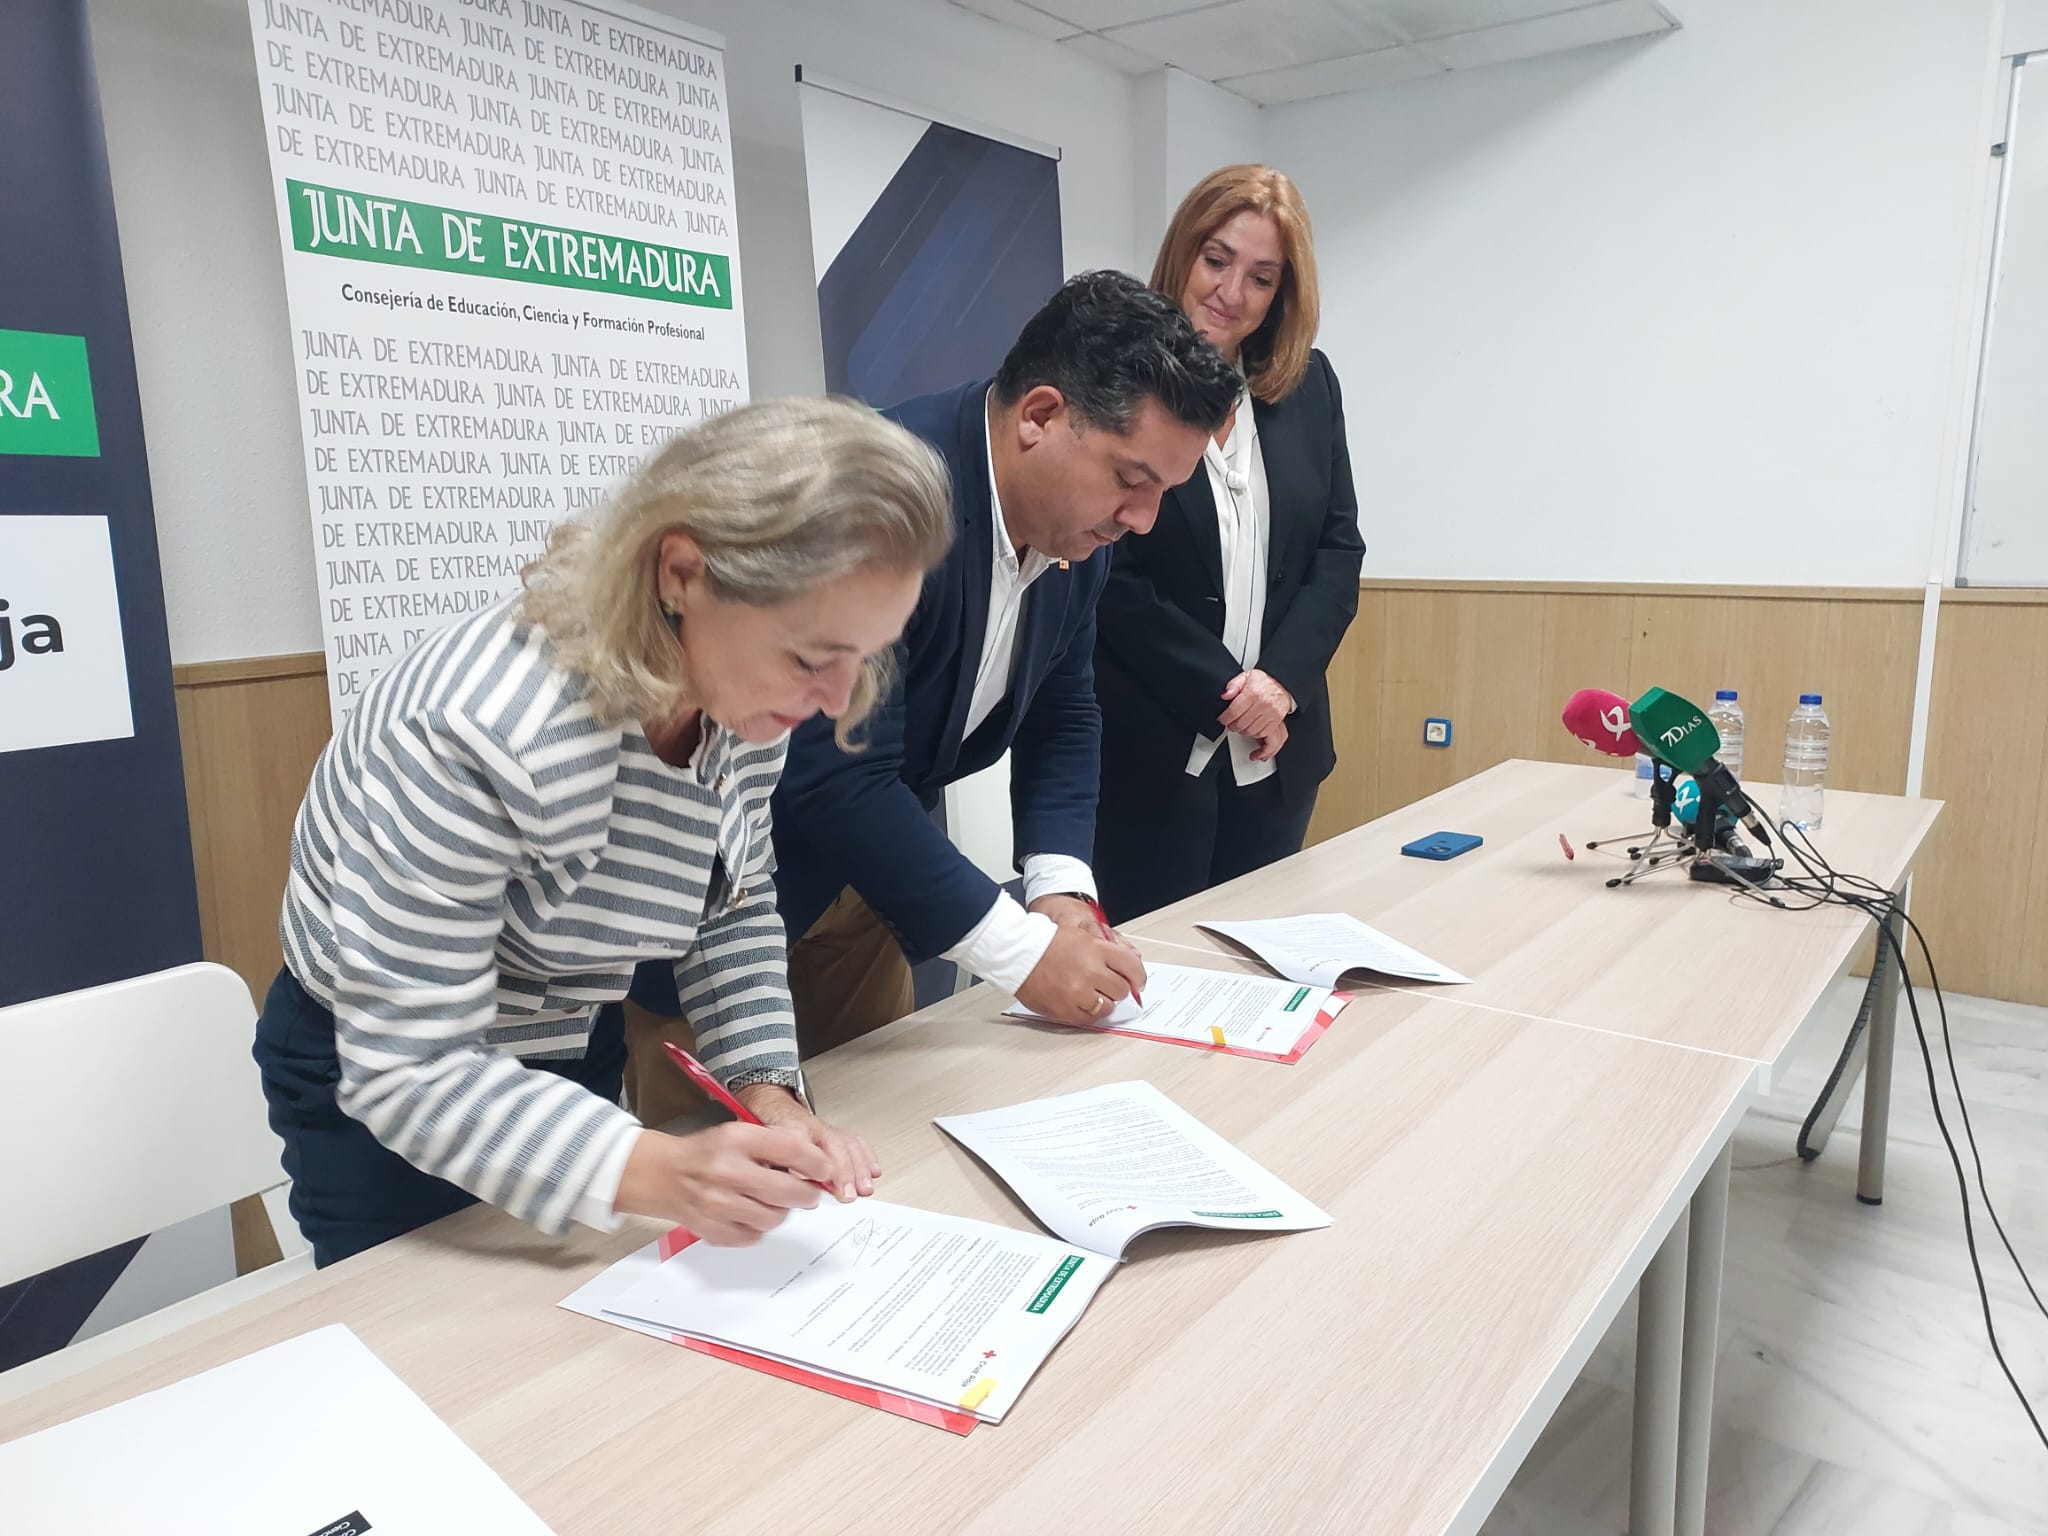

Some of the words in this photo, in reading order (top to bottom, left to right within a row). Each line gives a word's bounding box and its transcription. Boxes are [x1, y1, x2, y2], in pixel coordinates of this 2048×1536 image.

[459, 17, 516, 56] JUNTA
[524, 36, 546, 64] DE
[554, 45, 669, 100] EXTREMADURA
[676, 81, 720, 112] JUNTA
[520, 0, 573, 38] JUNTA
[580, 18, 602, 47] DE
[608, 27, 717, 81] EXTREMADURA
[264, 0, 329, 42] JUNTA
[339, 20, 366, 53] DE
[376, 31, 519, 93] EXTREMADURA
[528, 73, 579, 108] JUNTA
[587, 89, 607, 115] DE
[614, 96, 722, 144] EXTREMADURA
[266, 40, 295, 72] DE
[305, 50, 458, 114] EXTREMADURA
[467, 93, 523, 130] JUNTA
[530, 109, 552, 136] DE
[560, 116, 674, 165] EXTREMADURA
[680, 146, 724, 176] JUNTA
[272, 82, 338, 125] JUNTA
[348, 102, 375, 133] DE
[385, 111, 526, 165] EXTREMADURA
[533, 145, 584, 176] JUNTA
[593, 158, 611, 182] DE
[619, 163, 727, 207] EXTREMADURA
[277, 125, 304, 157] DE
[314, 134, 465, 189] EXTREMADURA
[474, 168, 528, 200] JUNTA
[536, 180, 557, 206] DE
[566, 185, 678, 229] EXTREMADURA
[684, 210, 728, 237] JUNTA
[303, 188, 423, 254] JUNTA
[442, 212, 485, 263] DE
[502, 223, 721, 297] EXTREMADURA
[341, 283, 423, 310] Consejería
[427, 293, 444, 311] de
[448, 296, 521, 322] Educación,
[523, 304, 569, 325] Ciencia
[572, 314, 579, 331] y
[583, 312, 645, 334] Formación
[648, 320, 705, 341] Profesional
[301, 330, 363, 360] JUNTA
[373, 337, 399, 363] DE
[408, 340, 544, 374] EXTREMADURA
[552, 354, 601, 378] JUNTA
[610, 358, 628, 380] DE
[636, 361, 740, 390] EXTREMADURA
[306, 368, 330, 396] DE
[339, 372, 486, 407] EXTREMADURA
[494, 383, 546, 409] JUNTA
[554, 386, 575, 410] DE
[583, 389, 691, 416] EXTREMADURA
[698, 397, 737, 421] JUNT
[310, 408, 370, 438] JUNTA
[381, 413, 405, 437] DE
[416, 414, 549, 442] EXTREMADURA
[558, 421, 606, 446] JUNTA
[616, 424, 634, 445] DE
[314, 447, 338, 472] DE
[348, 449, 491, 474] EXTREMADURA
[501, 453, 551, 478] JUNTA
[561, 455, 580, 475] DE
[317, 485, 378, 515] JUNTA
[388, 485, 413, 511] DE
[423, 486, 555, 509] EXTREMADURA
[323, 524, 345, 548] DE
[355, 521, 497, 546] EXTREMADURA
[327, 560, 384, 590] JUNTA
[394, 557, 422, 582] DE
[431, 553, 545, 580] EXTREMAD
[329, 597, 354, 624] DE
[334, 632, 394, 664] JUNTA
[338, 671, 361, 696] DE
